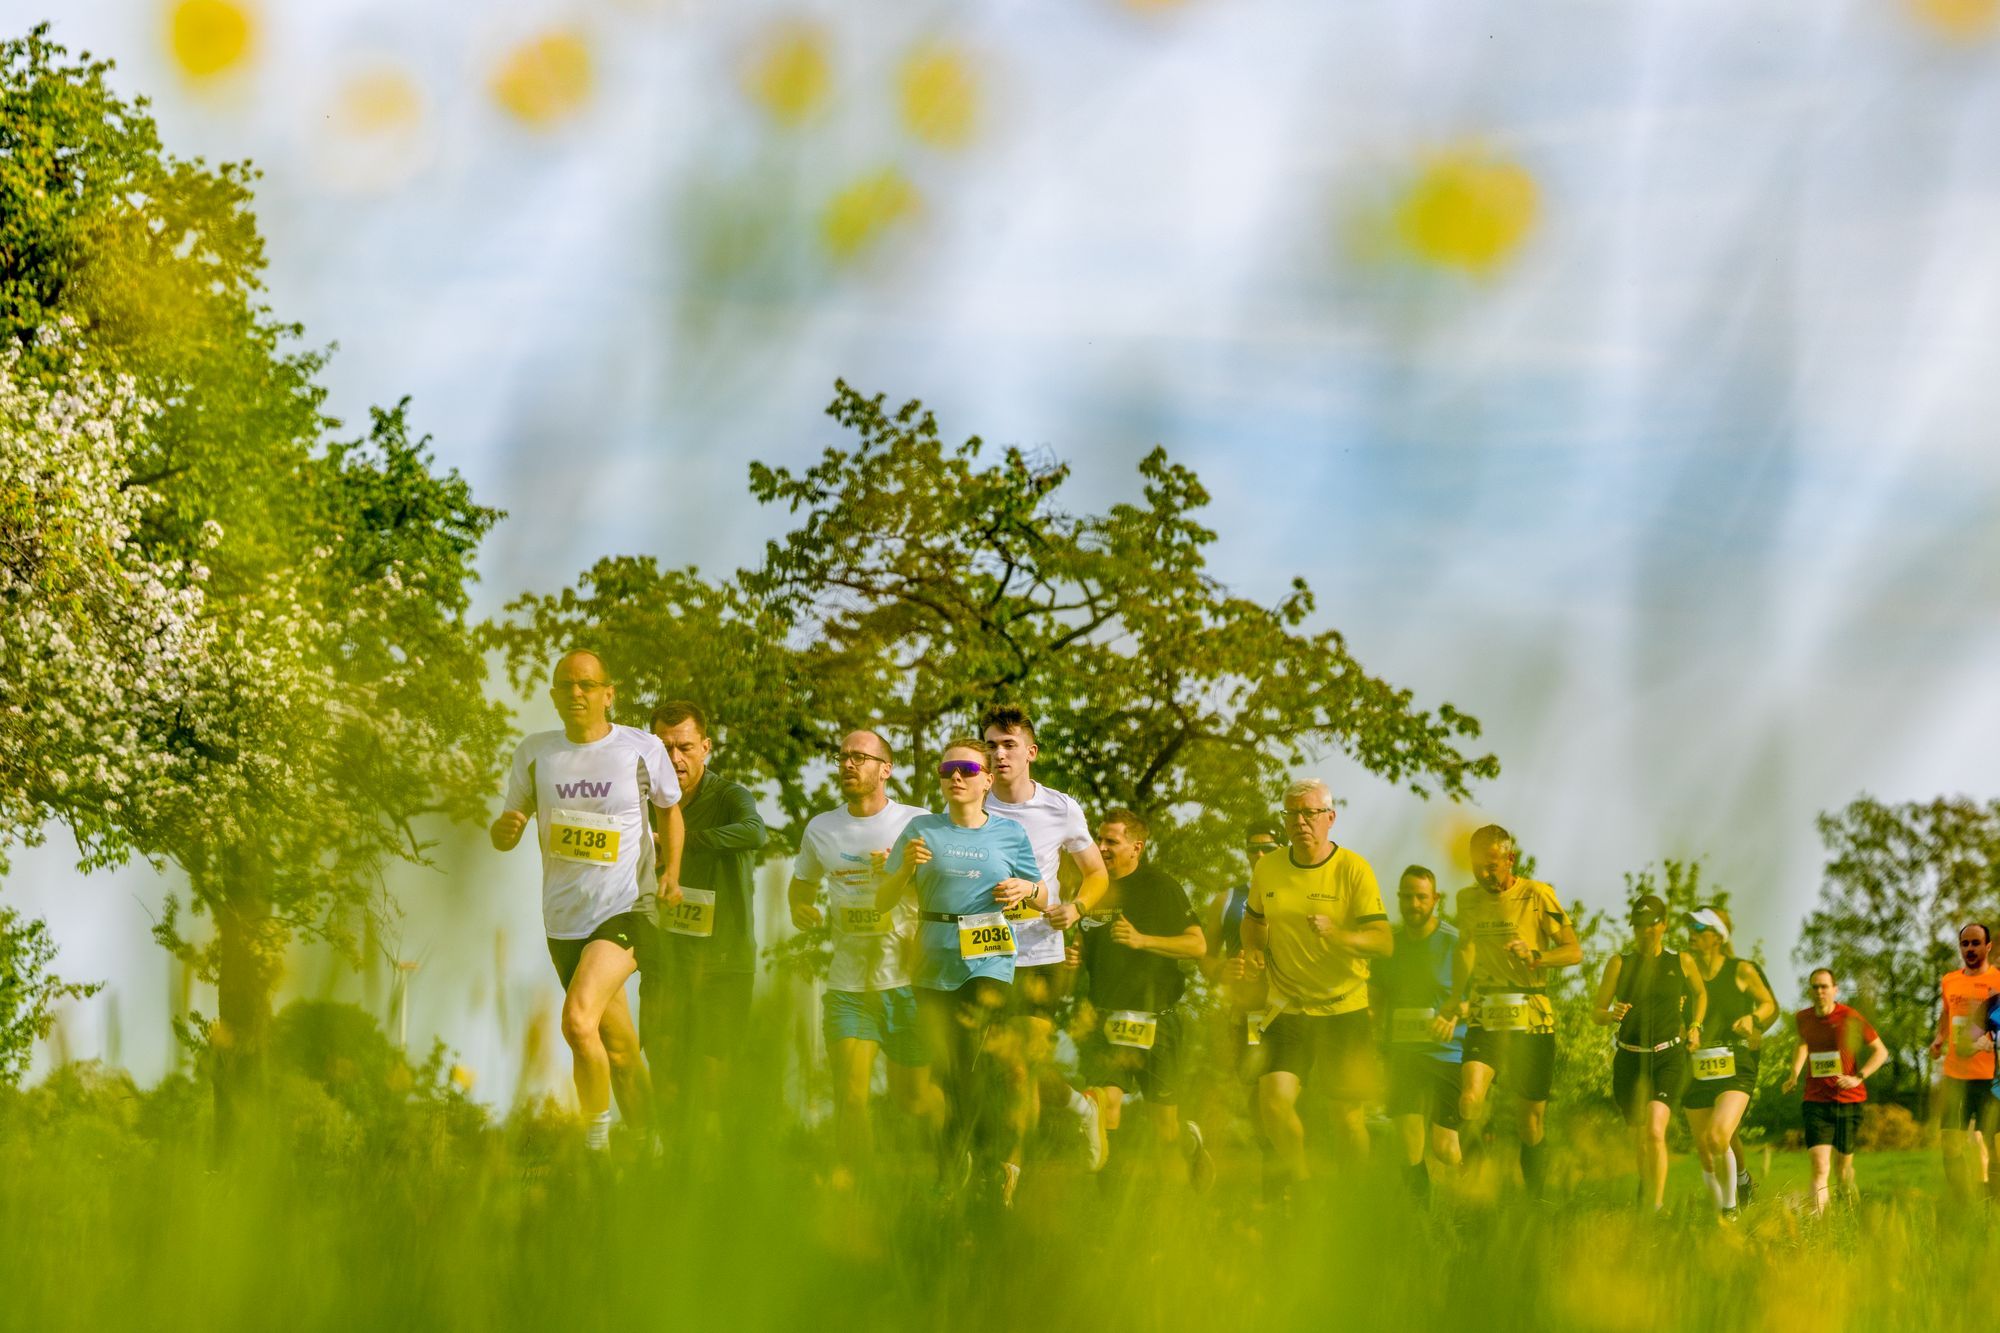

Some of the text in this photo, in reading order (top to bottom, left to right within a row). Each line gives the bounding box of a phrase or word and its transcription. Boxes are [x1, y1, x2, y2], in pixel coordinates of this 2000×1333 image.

[555, 779, 612, 799] wtw
[561, 828, 607, 848] 2138
[574, 848, 591, 857] Uwe
[848, 910, 881, 923] 2035
[972, 927, 1011, 944] 2036
[1112, 1021, 1145, 1036] 2147
[1699, 1058, 1727, 1070] 2119
